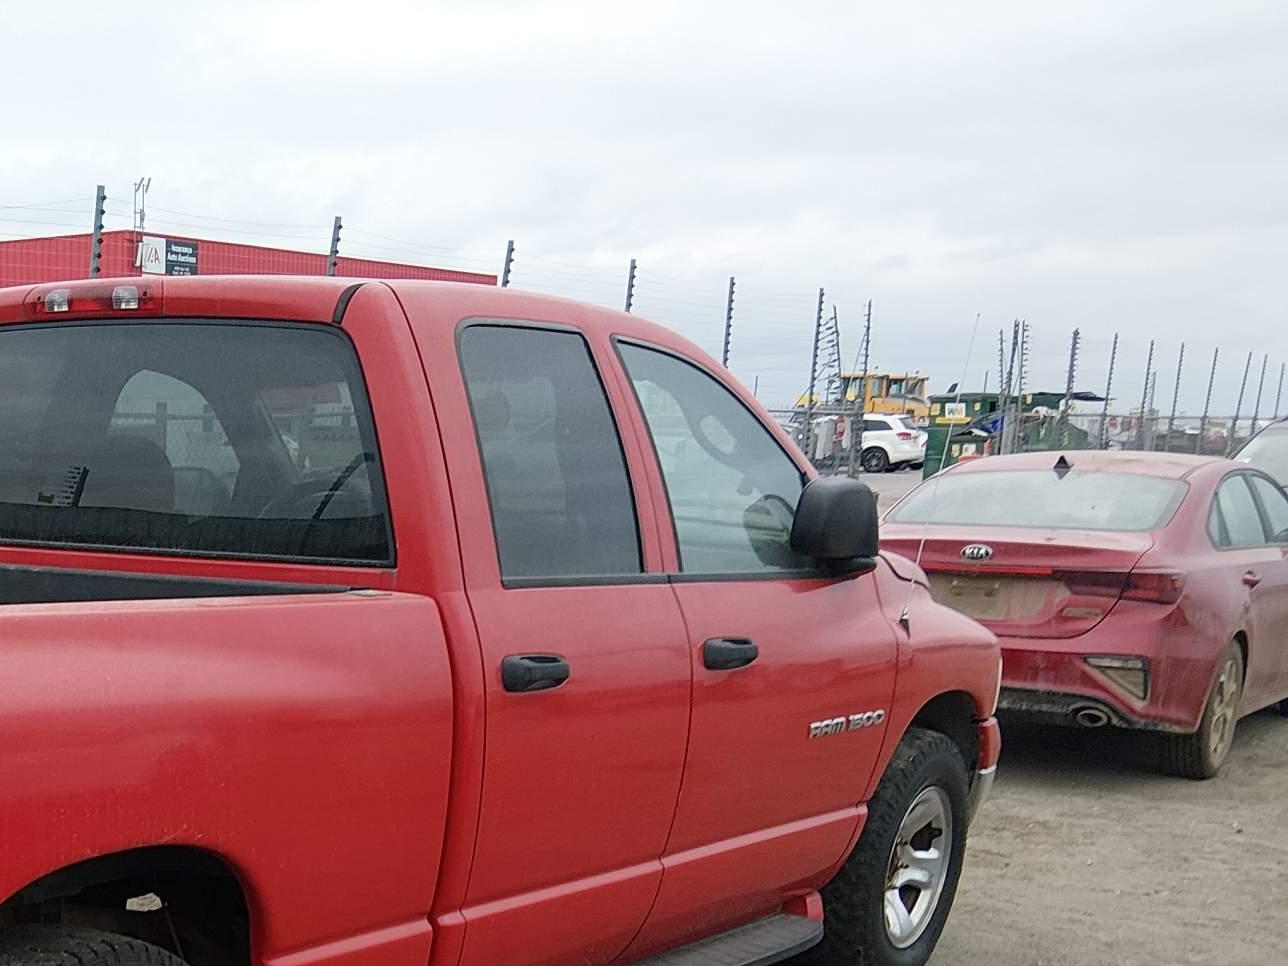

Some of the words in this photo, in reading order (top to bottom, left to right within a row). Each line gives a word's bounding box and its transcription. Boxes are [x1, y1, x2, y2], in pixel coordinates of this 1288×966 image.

[965, 547, 987, 559] KIA
[810, 717, 847, 739] RAM
[848, 709, 885, 731] 1500
